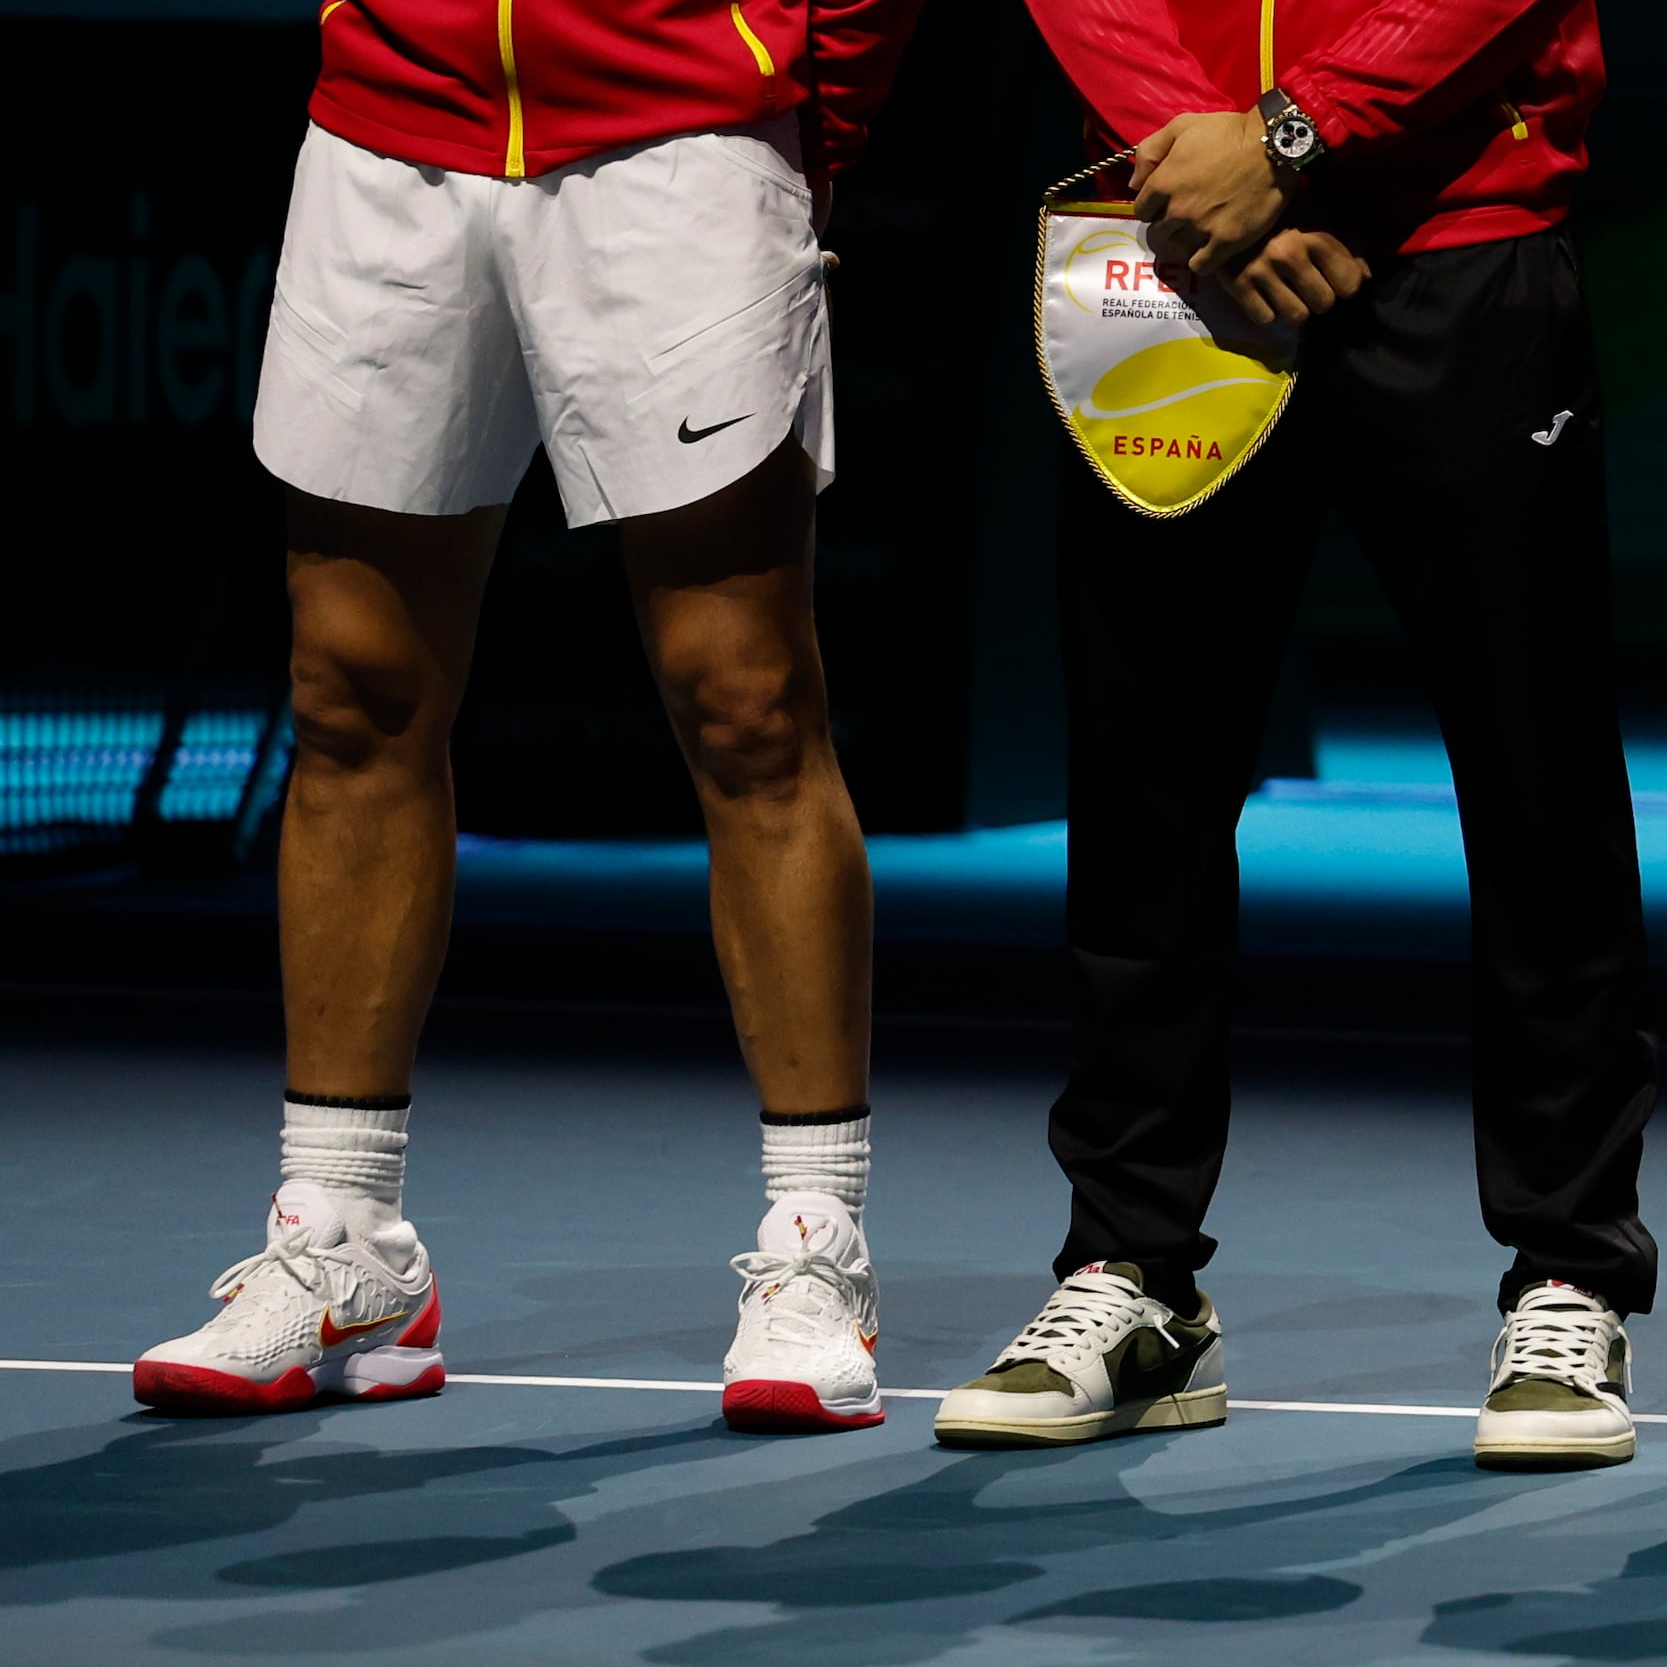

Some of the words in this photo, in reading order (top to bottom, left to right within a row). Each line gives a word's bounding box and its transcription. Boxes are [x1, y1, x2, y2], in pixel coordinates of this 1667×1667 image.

[1102, 298, 1128, 308] REAL
[1131, 299, 1196, 311] FEDERACIÓN
[1102, 307, 1153, 319] ESPAÑOLA
[1156, 310, 1169, 320] DE
[1172, 311, 1201, 321] TENIS
[1113, 434, 1223, 460] ESPAÑA
